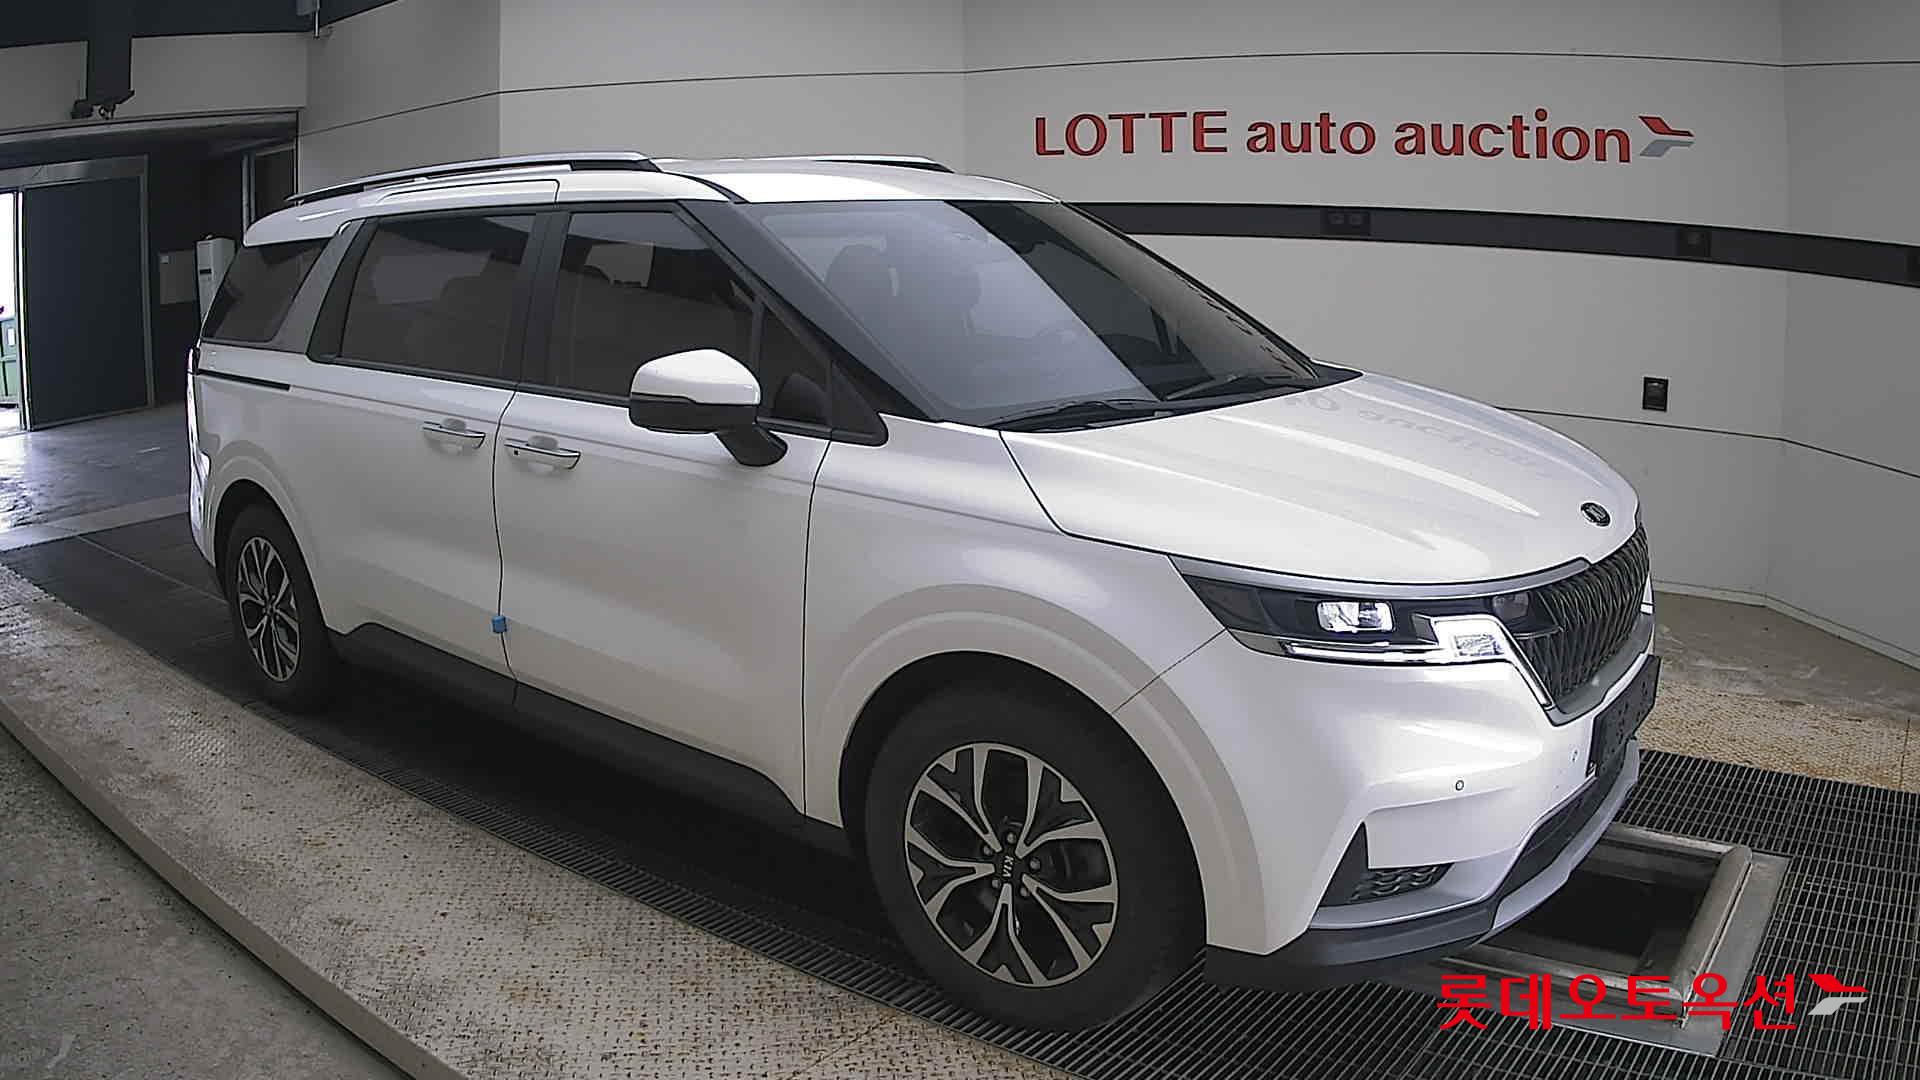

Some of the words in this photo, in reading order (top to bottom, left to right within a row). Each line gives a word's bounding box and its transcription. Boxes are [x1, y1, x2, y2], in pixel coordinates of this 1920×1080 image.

[1035, 111, 1228, 156] LOTTE
[1246, 112, 1377, 155] auto
[1394, 108, 1632, 163] auction
[1002, 855, 1015, 878] KIA
